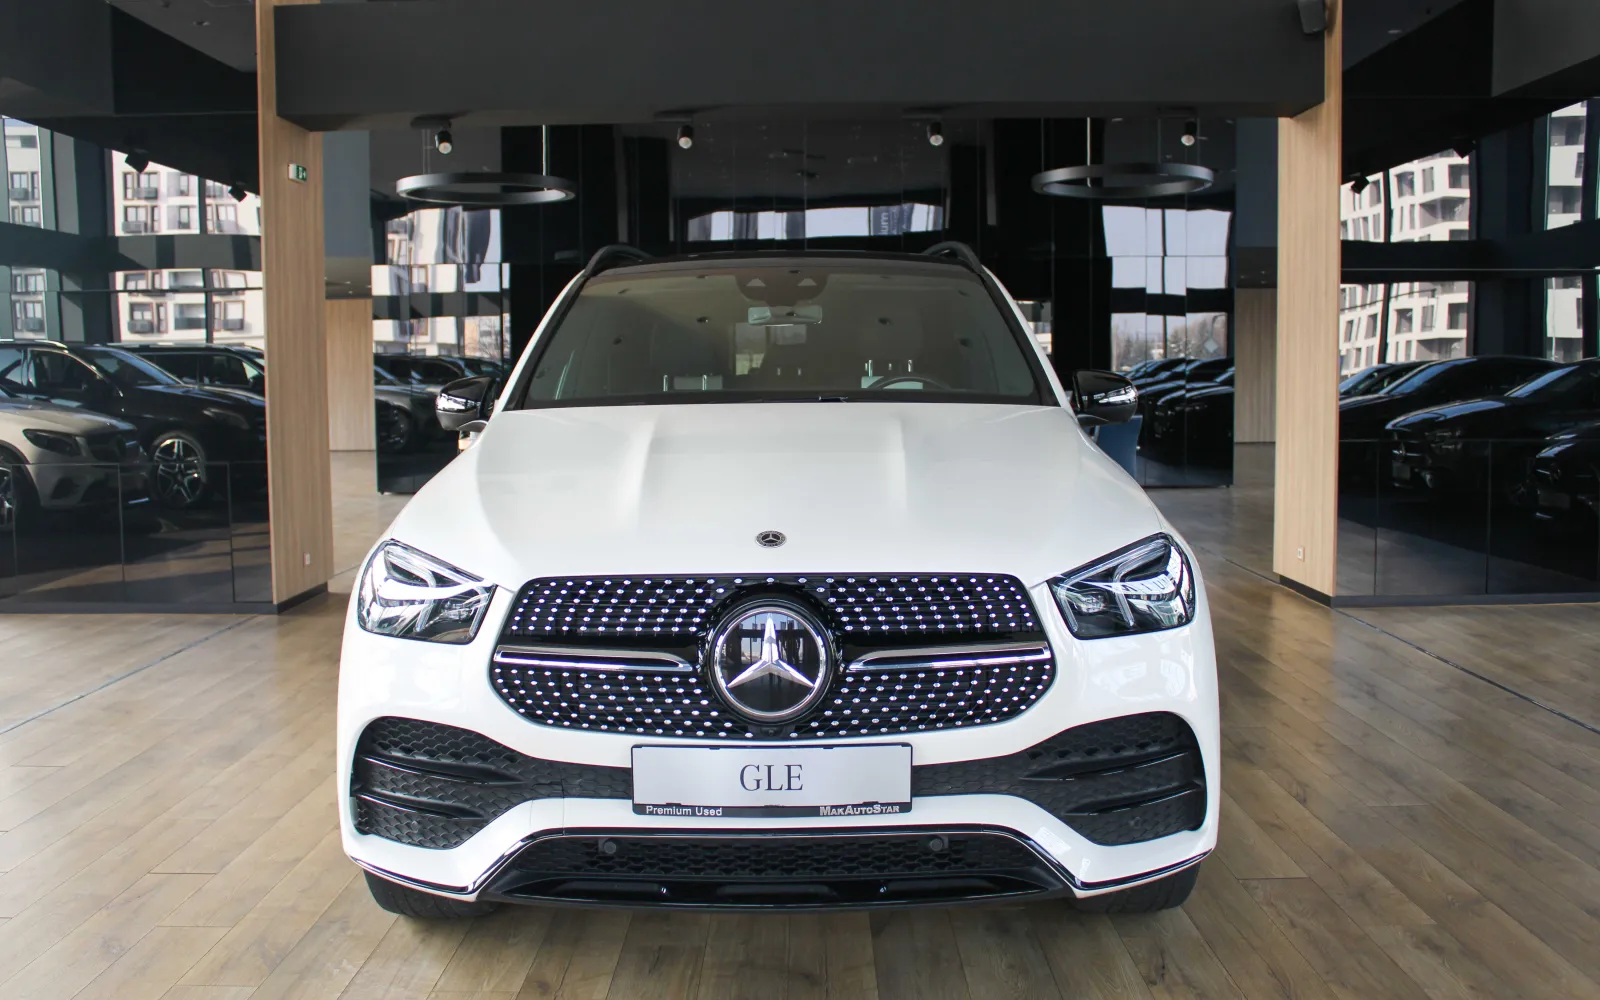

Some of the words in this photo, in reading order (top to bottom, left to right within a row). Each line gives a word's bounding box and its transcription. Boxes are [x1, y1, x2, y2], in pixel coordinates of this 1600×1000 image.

[739, 764, 803, 791] GLE
[646, 805, 692, 816] Premium
[695, 807, 722, 816] Used
